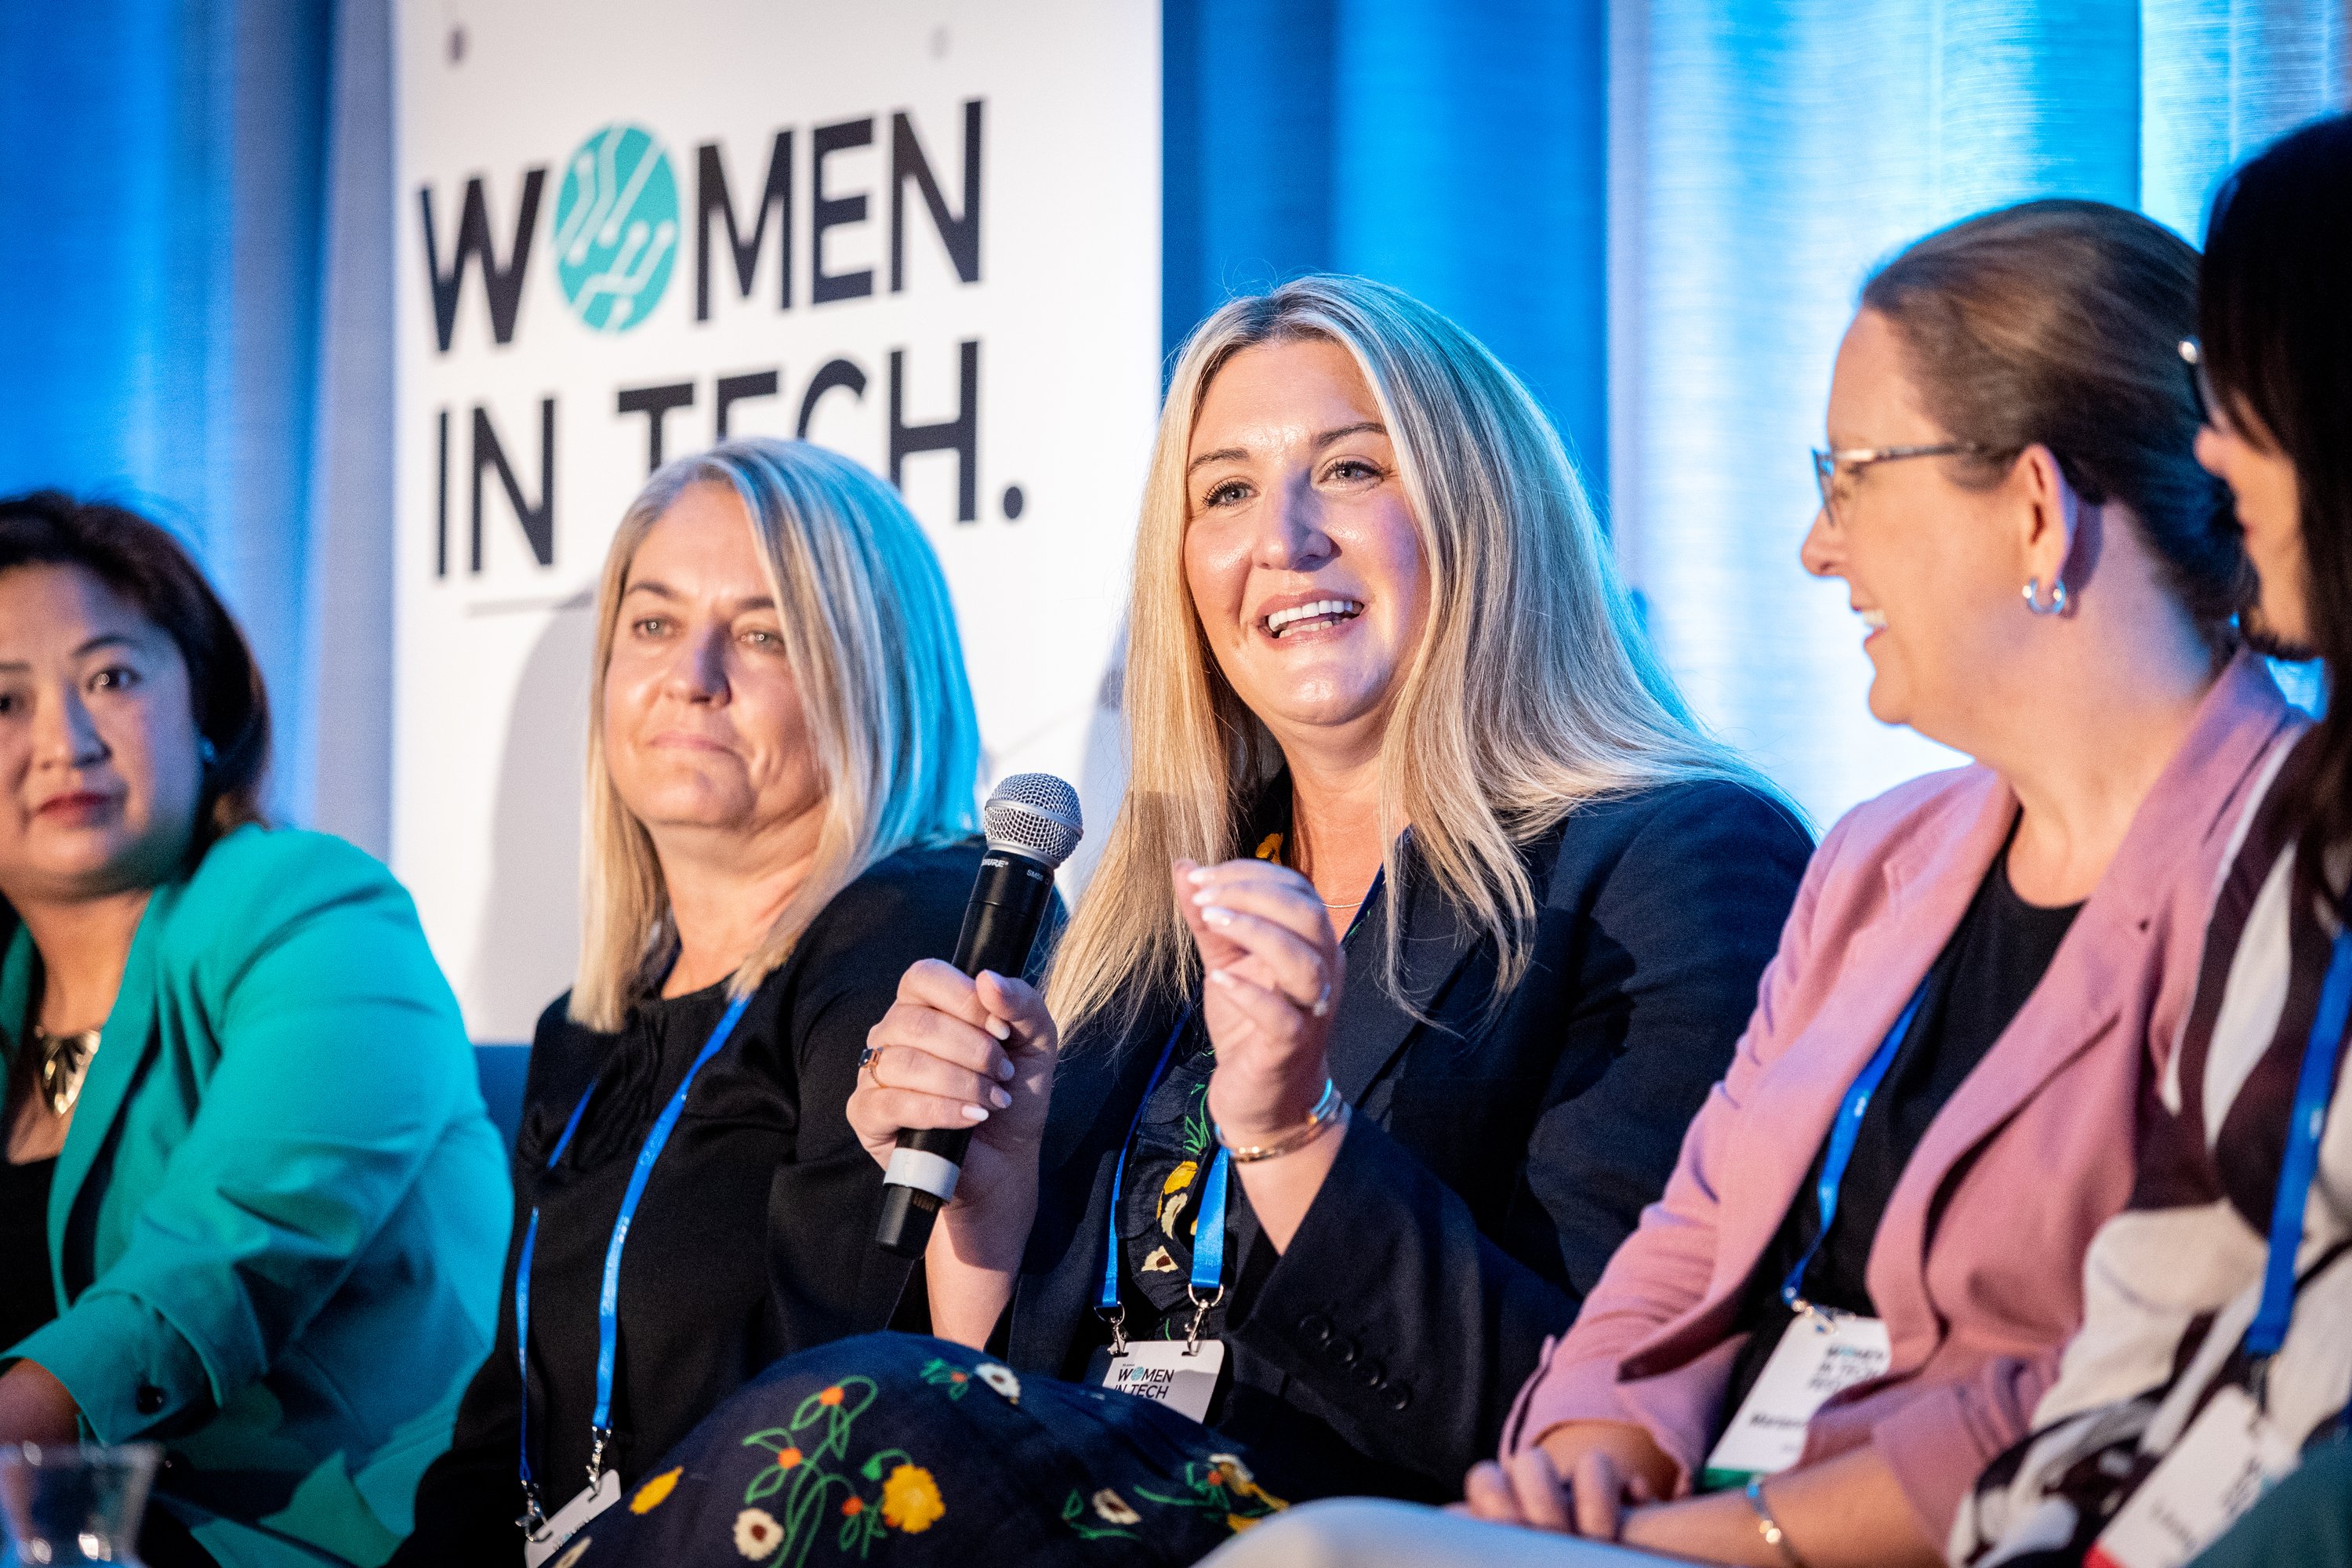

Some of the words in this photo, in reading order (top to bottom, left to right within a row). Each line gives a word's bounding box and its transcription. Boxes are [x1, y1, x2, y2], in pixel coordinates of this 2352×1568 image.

[417, 97, 987, 354] WOMEN
[436, 397, 557, 579] IN
[1118, 1367, 1174, 1383] WOMEN
[1131, 1384, 1169, 1399] TECH
